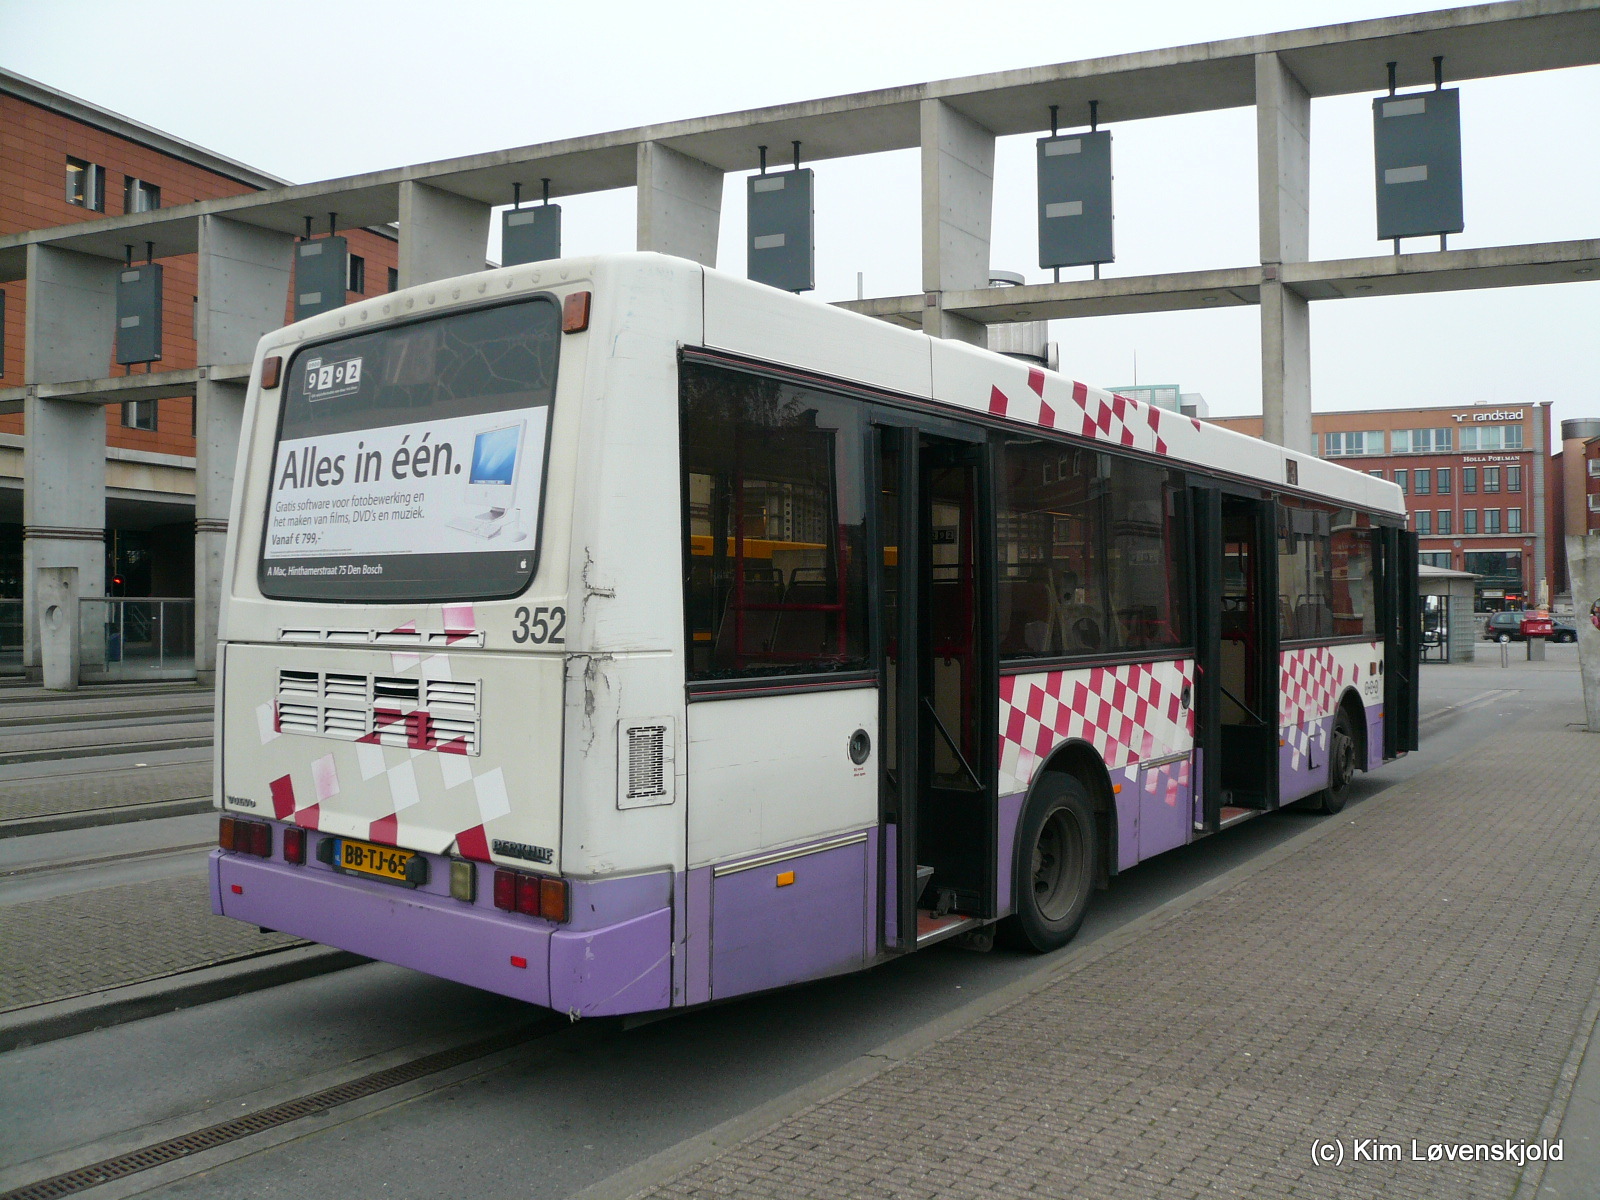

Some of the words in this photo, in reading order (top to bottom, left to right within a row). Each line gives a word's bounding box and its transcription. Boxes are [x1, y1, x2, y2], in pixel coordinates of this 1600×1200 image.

[308, 363, 357, 389] 9292
[1473, 409, 1524, 421] randstad
[278, 445, 346, 490] Alles
[354, 441, 382, 484] in
[391, 432, 462, 480] één.
[275, 501, 296, 513] Gratis
[297, 498, 331, 512] software
[332, 497, 350, 509] voor
[351, 491, 411, 507] fotobewerking
[413, 492, 425, 502] en
[273, 516, 286, 527] het
[287, 514, 312, 527] maken
[313, 515, 328, 525] van
[329, 511, 351, 525] films,
[352, 509, 377, 523] DVD's
[378, 511, 389, 521] en
[391, 506, 425, 520] muziek.
[271, 531, 294, 545] Vanaf
[295, 534, 301, 544] €
[266, 566, 273, 576] A
[273, 566, 287, 577] Mac,
[287, 565, 338, 576] Hinthamerstraat
[338, 565, 347, 575] 75
[347, 564, 362, 575] Den
[362, 563, 383, 575] Bosch
[512, 606, 567, 645] 352
[344, 844, 407, 876] BB-TJ-65
